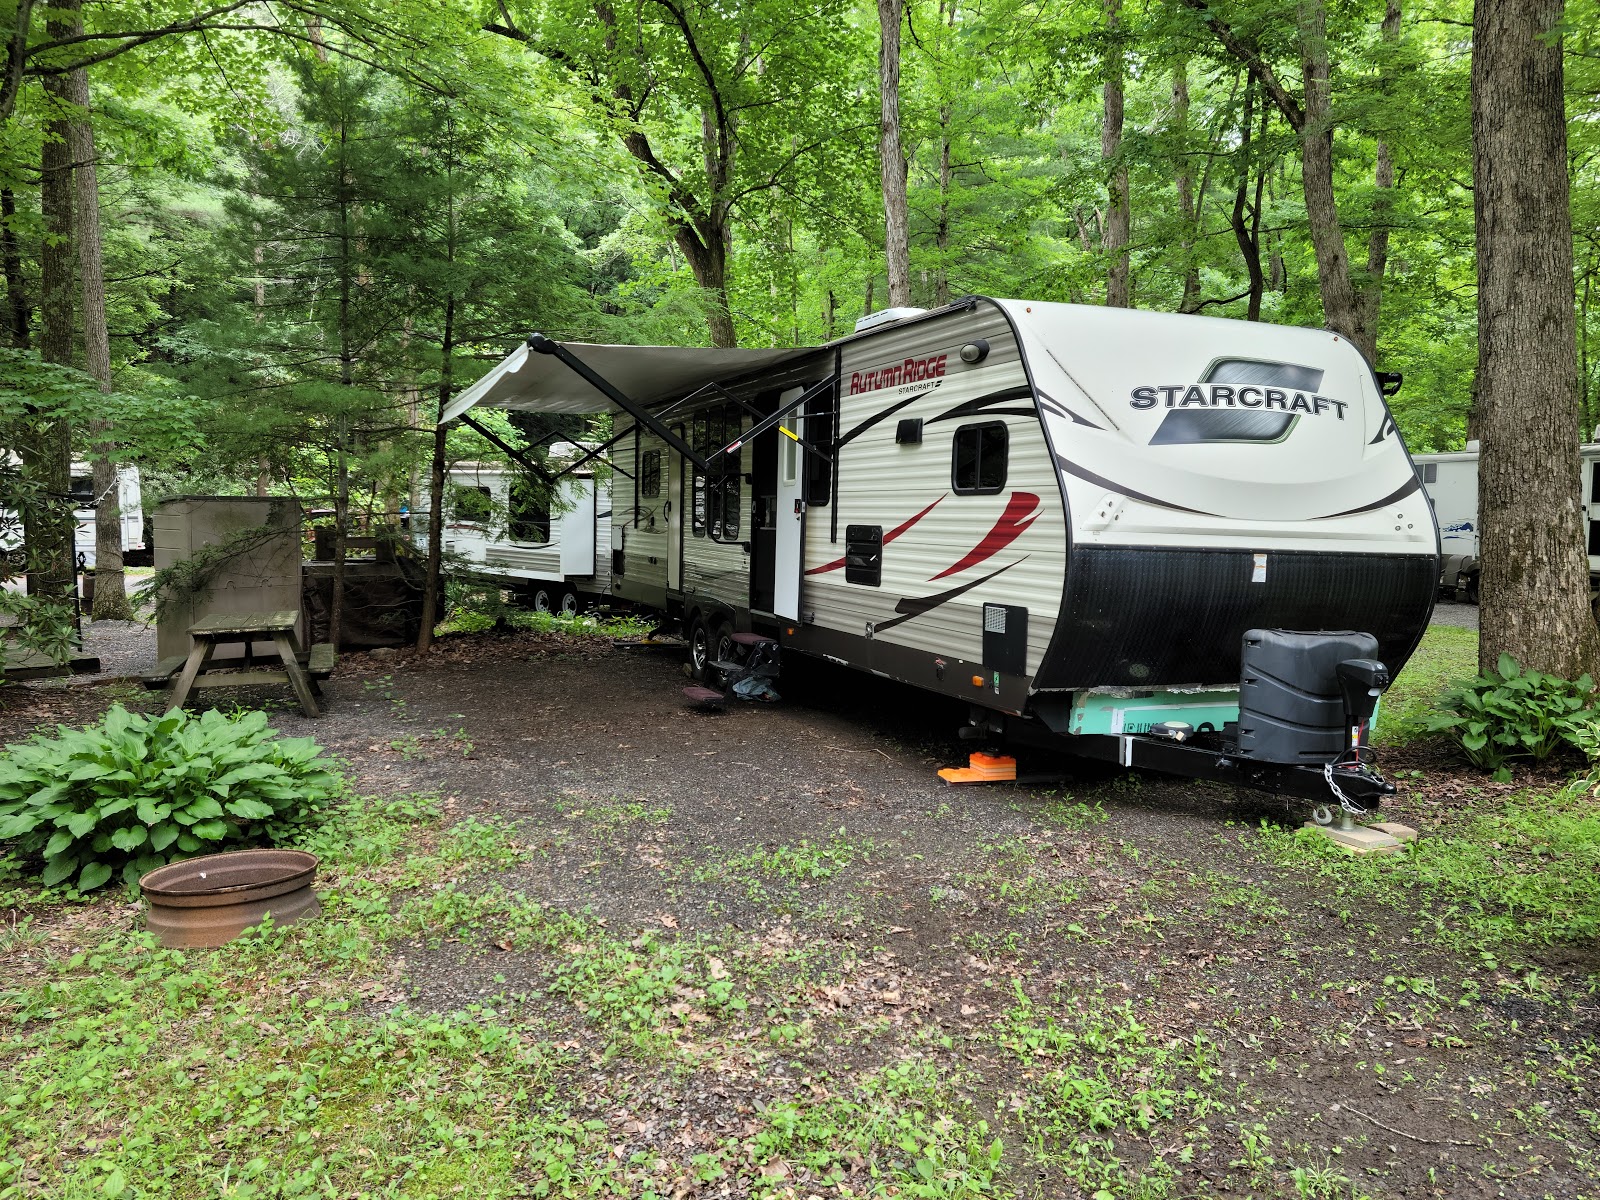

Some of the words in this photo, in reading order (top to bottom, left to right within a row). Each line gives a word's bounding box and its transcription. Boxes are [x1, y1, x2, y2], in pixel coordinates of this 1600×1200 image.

[850, 366, 902, 395] AUTUMN
[903, 354, 948, 384] RIDGE
[898, 381, 935, 395] STARCRAFT
[1129, 384, 1349, 421] STARCRAFT
